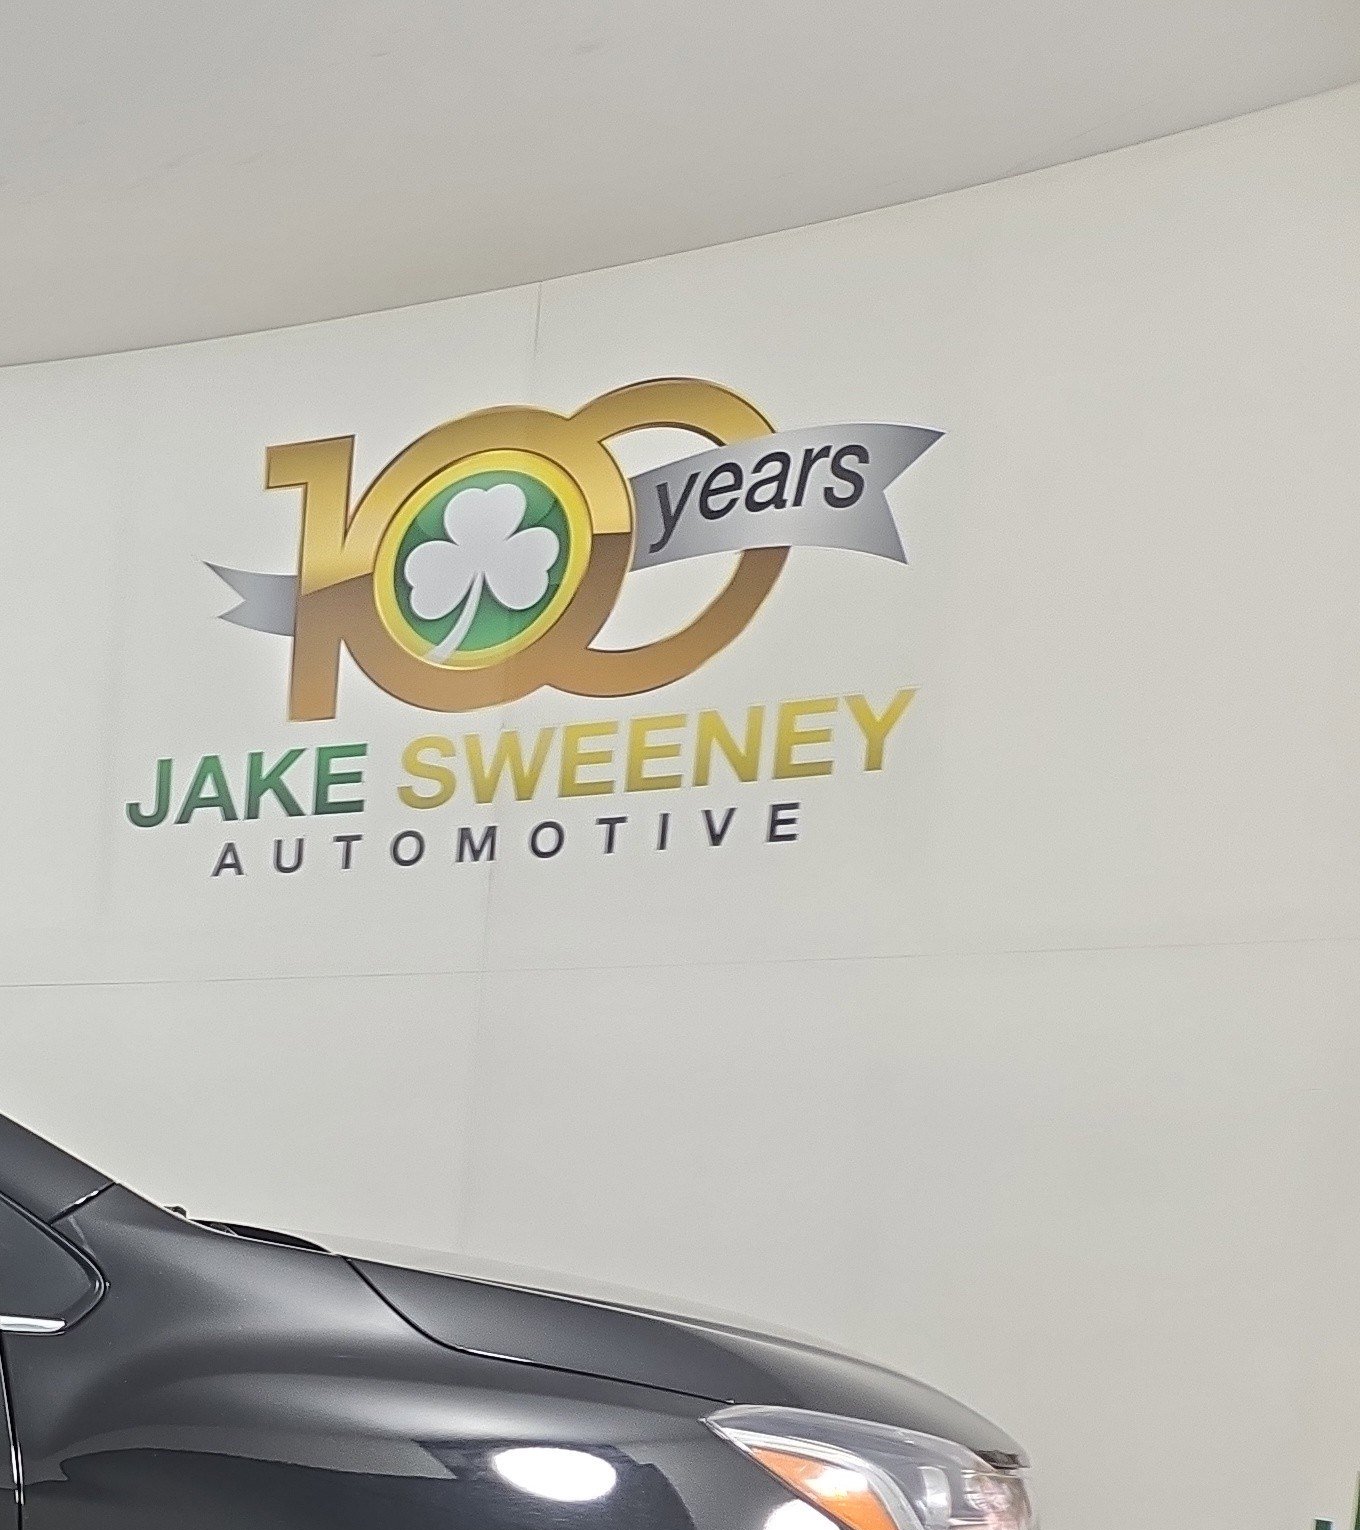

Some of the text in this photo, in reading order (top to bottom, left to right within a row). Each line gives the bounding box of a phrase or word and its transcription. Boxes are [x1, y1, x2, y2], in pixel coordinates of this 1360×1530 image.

[648, 441, 869, 555] years
[125, 686, 920, 828] JAKE SWEENEY
[211, 801, 801, 877] AUTOMOTIVE
